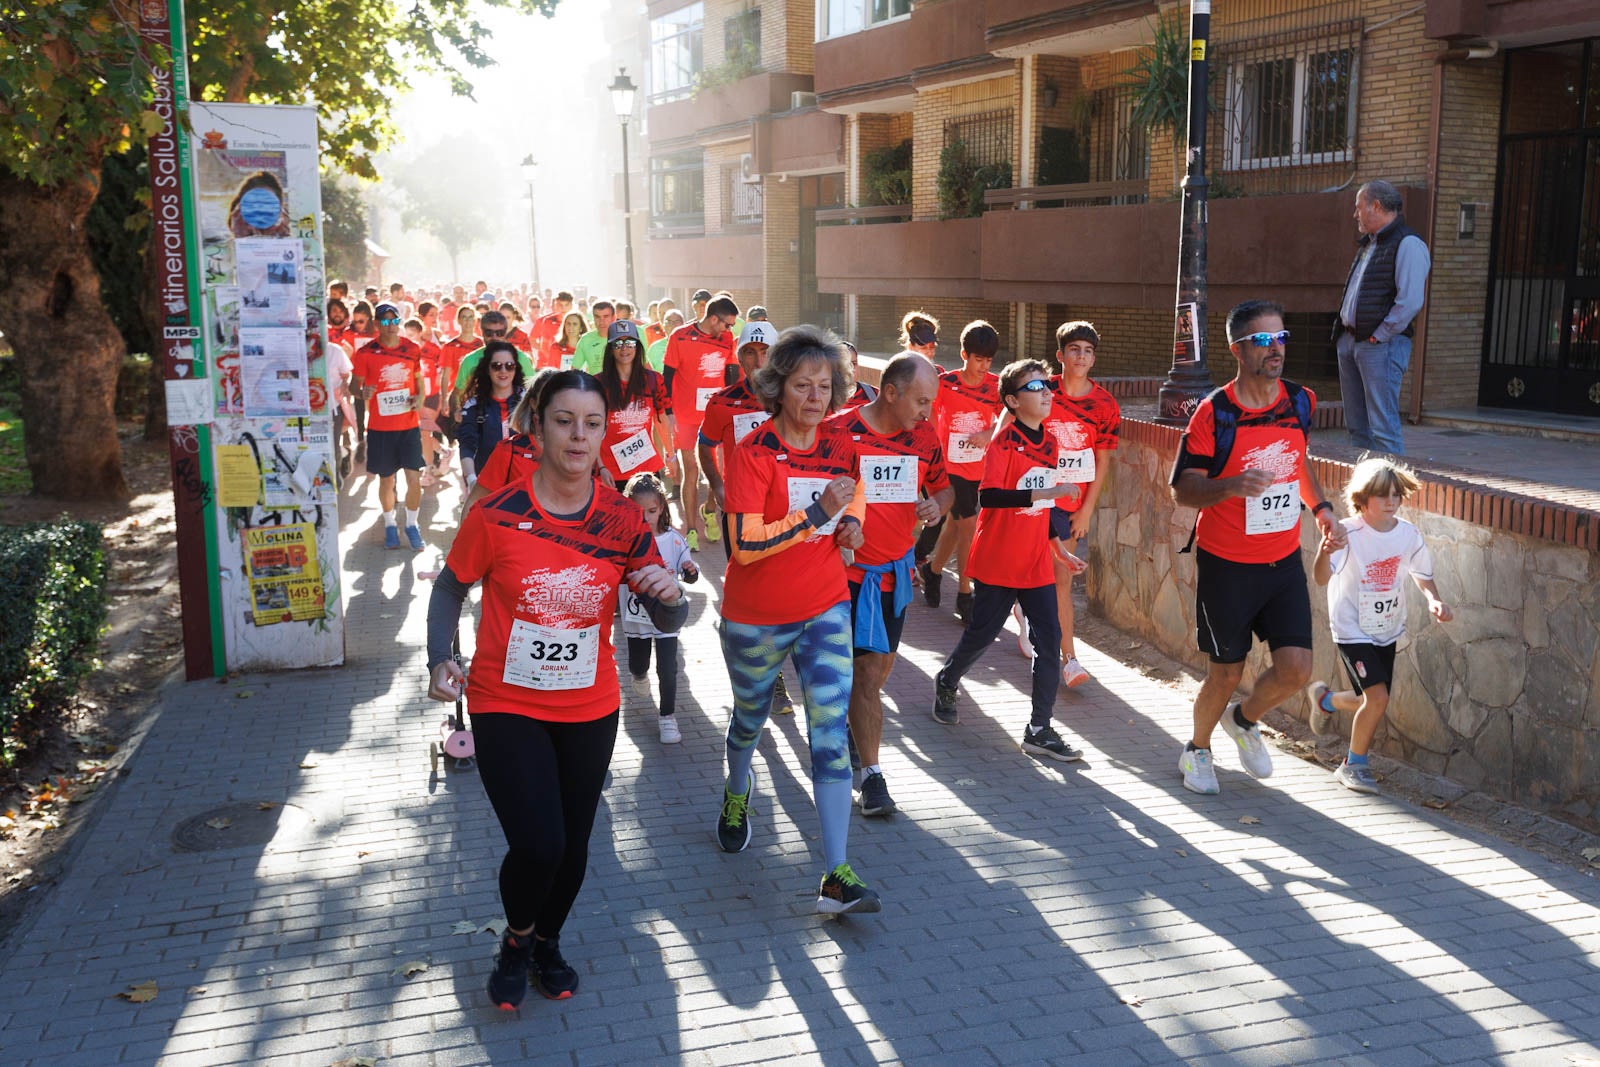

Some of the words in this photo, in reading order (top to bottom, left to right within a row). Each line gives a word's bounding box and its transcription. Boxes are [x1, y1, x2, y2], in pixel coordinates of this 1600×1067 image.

[158, 195, 184, 305] tinerarios
[166, 329, 199, 337] MPS
[620, 439, 645, 458] 1350
[1059, 458, 1082, 468] 971
[873, 466, 901, 480] 817
[1025, 476, 1045, 488] 818
[1262, 494, 1290, 511] 972
[247, 531, 303, 544] MOLINA
[289, 586, 309, 599] 149
[524, 588, 603, 603] carrera
[1374, 596, 1399, 614] 974
[530, 640, 578, 661] 323
[540, 664, 569, 672] ADRIANA
